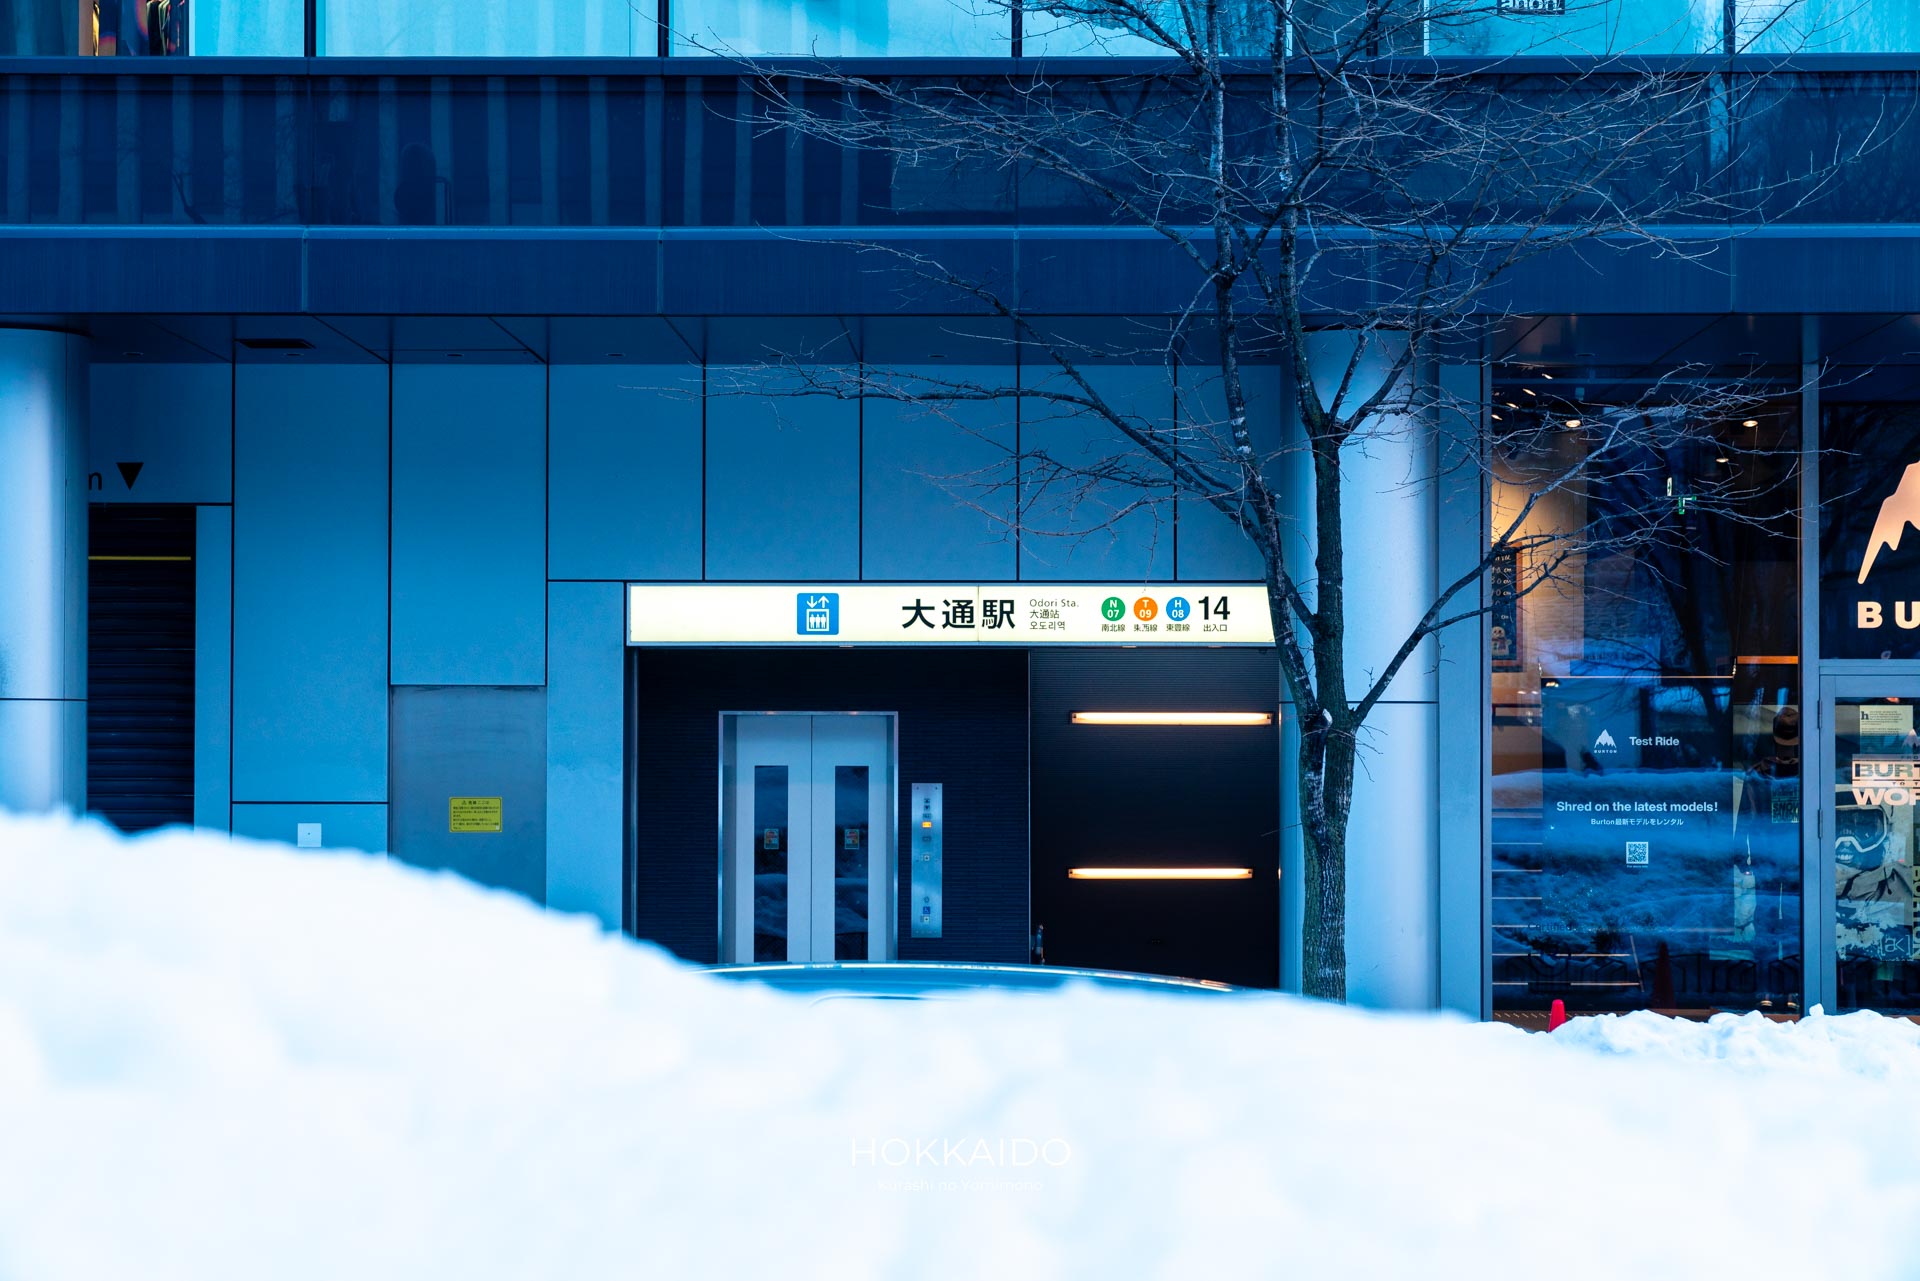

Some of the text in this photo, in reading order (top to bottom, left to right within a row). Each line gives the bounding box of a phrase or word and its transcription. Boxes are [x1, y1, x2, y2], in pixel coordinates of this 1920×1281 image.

[1029, 598, 1080, 608] Odori Sta.
[1109, 599, 1118, 608] N
[1142, 599, 1150, 608] T
[1174, 599, 1182, 608] H
[1198, 596, 1231, 621] 14
[902, 598, 1016, 630] 大通駅
[1029, 609, 1060, 619] 大通站
[1107, 609, 1120, 619] 07
[1139, 609, 1152, 619] 09
[1171, 609, 1185, 619] 08
[1029, 621, 1066, 631] 오도리역
[1101, 624, 1126, 632] 南北線
[1203, 624, 1228, 632] 出入口
[1629, 736, 1680, 746] Test Ride
[1556, 801, 1718, 812] Shred on the latest models!
[1590, 818, 1684, 826] Burton最新モデルをレンタル
